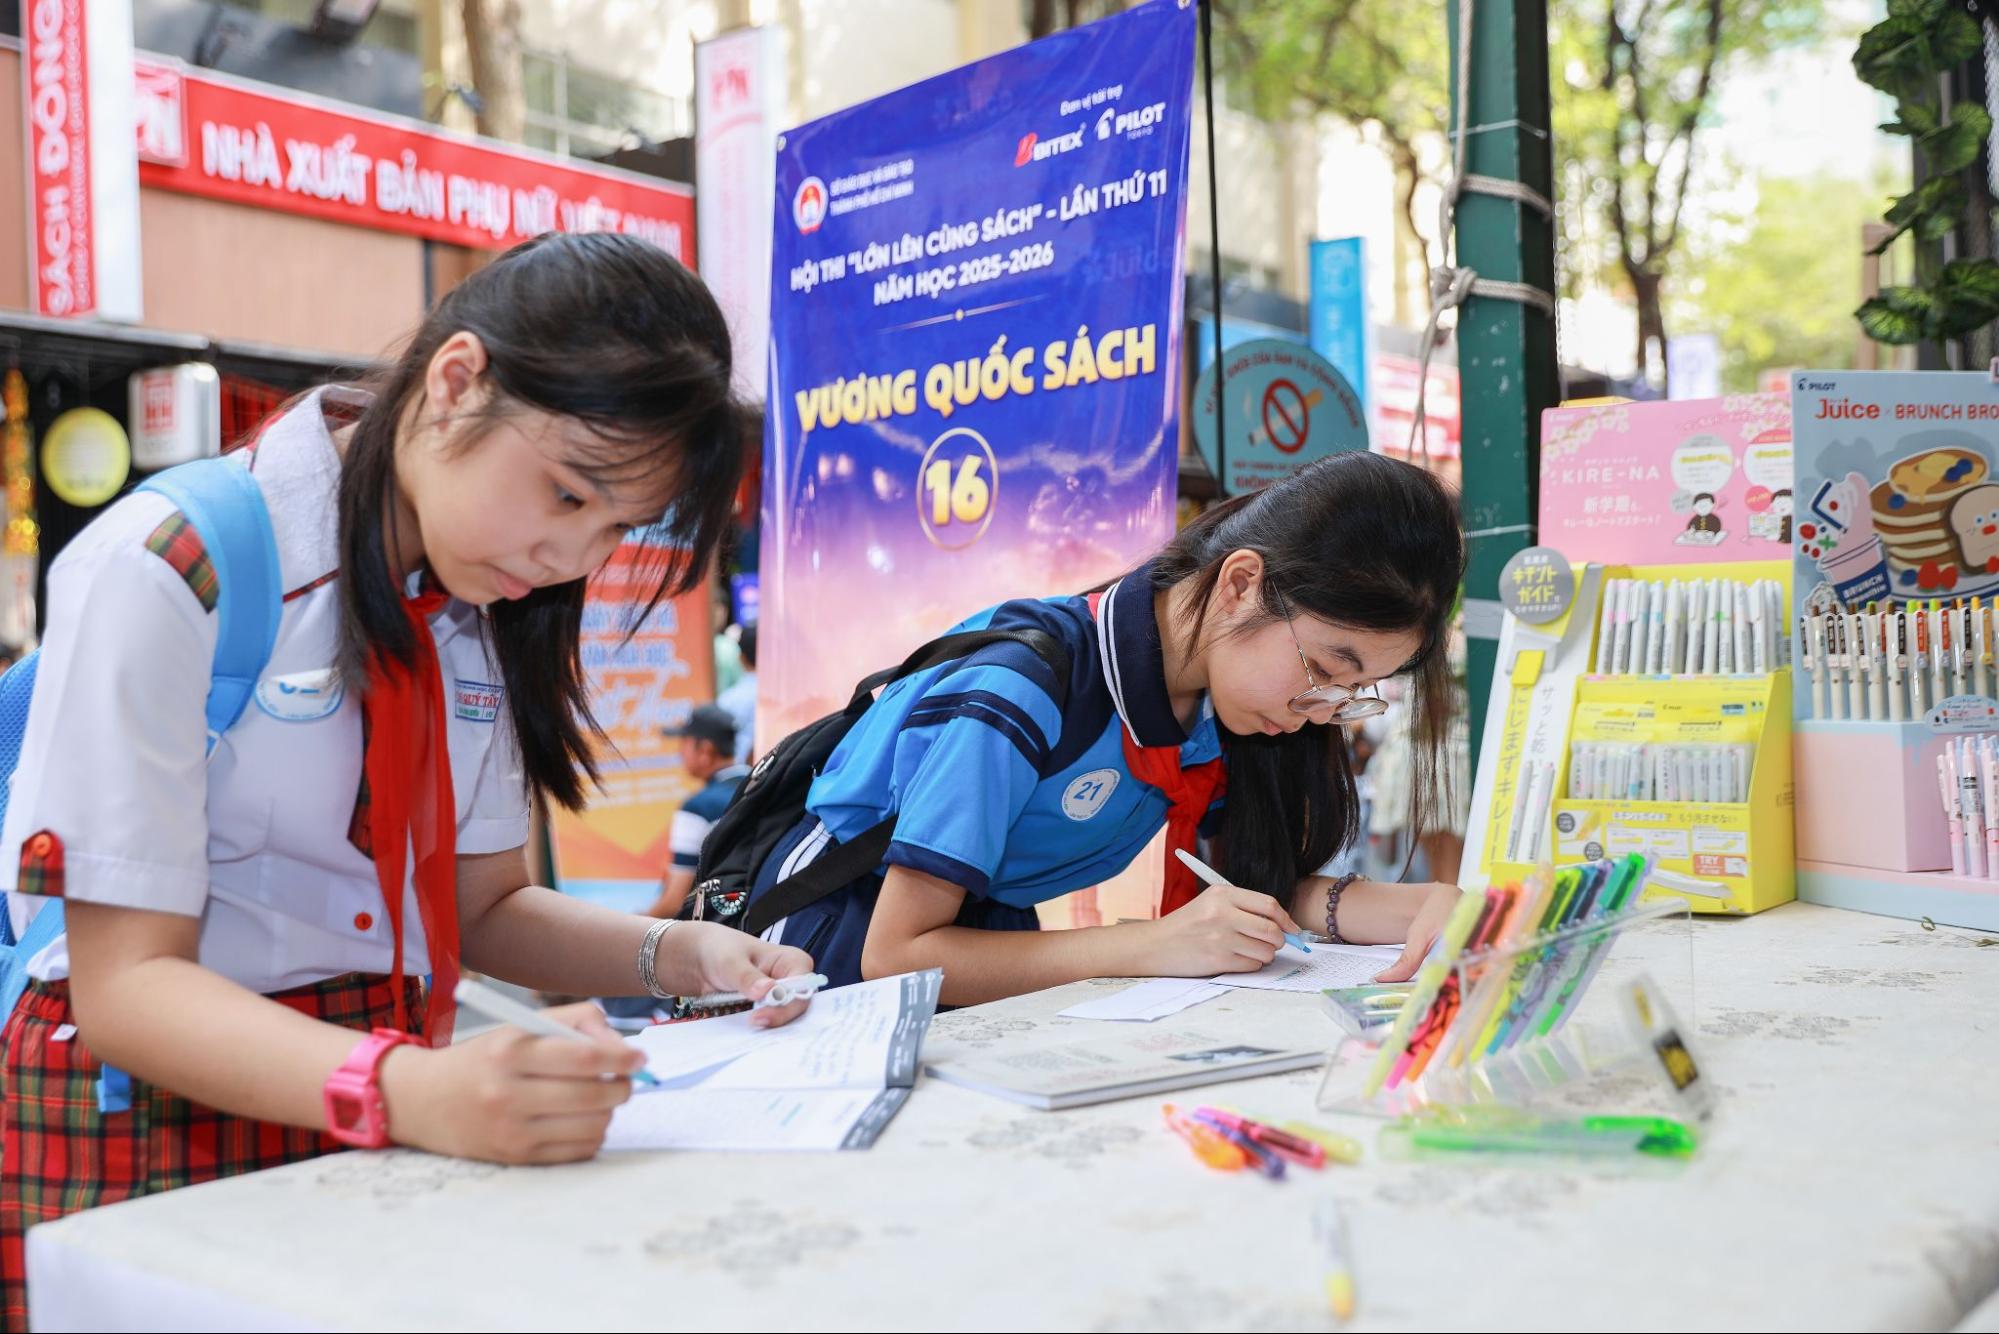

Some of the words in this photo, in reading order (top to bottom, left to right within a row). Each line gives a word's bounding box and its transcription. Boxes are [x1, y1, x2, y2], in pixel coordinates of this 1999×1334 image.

[1115, 102, 1166, 135] PILOT
[202, 121, 283, 190] NHÀ
[285, 133, 373, 206] XUẤT
[375, 149, 445, 222] BẢN
[448, 173, 510, 238] PHỤ
[513, 184, 557, 239] NỮ
[42, 184, 75, 316] SÁCH
[791, 262, 819, 294] HỘI
[820, 256, 845, 284] THI
[892, 236, 924, 268] LÊN
[926, 226, 979, 257] CÙNG
[1101, 169, 1146, 209] THỨ
[1148, 168, 1168, 198] 11
[874, 274, 912, 305] NĂM
[915, 267, 955, 300] HỌC
[958, 241, 1055, 284] 2025-2026
[795, 369, 917, 433] VƯƠNG
[924, 334, 1036, 419] QUỐC
[1043, 323, 1157, 390] SÁCH
[1815, 398, 1881, 420] Juice
[1895, 404, 1961, 420] BRUNCH
[925, 453, 989, 528] 16
[1562, 465, 1660, 484] KIRE-NA
[1073, 781, 1104, 801] 21
